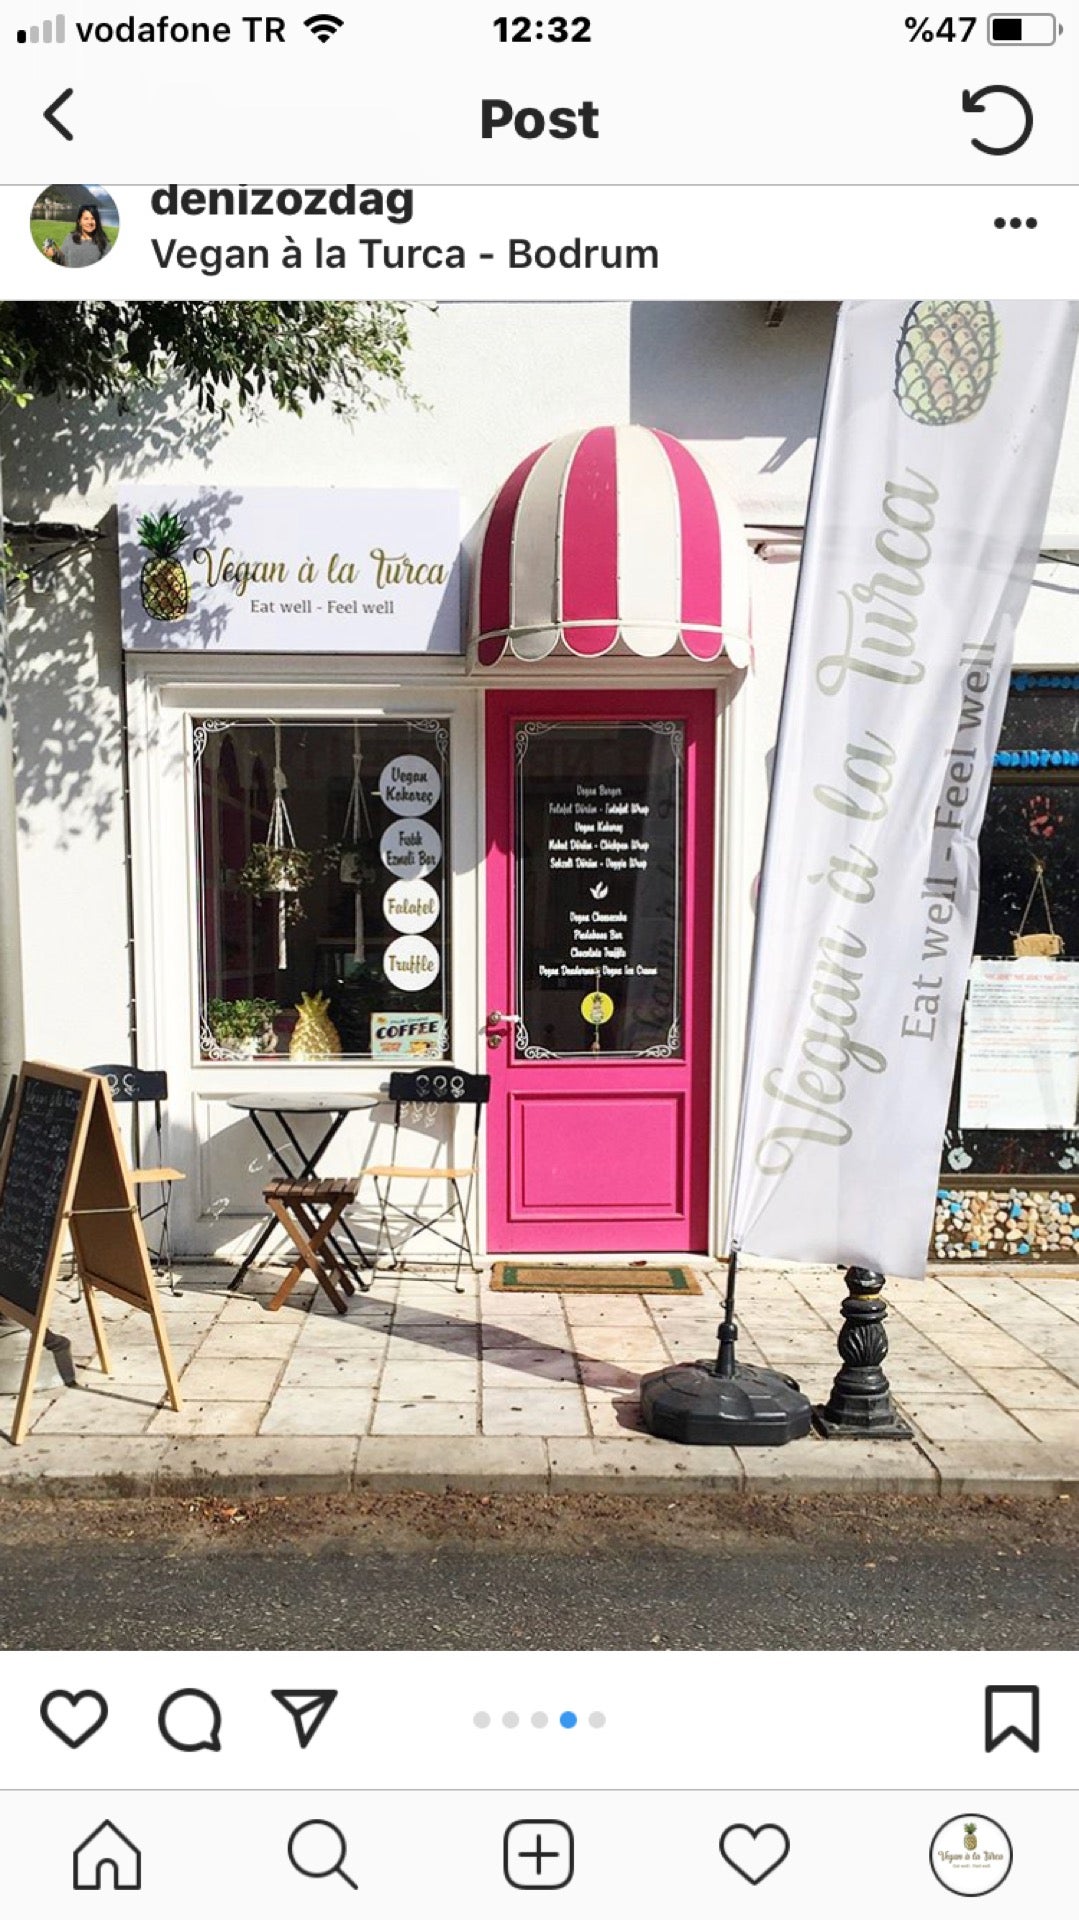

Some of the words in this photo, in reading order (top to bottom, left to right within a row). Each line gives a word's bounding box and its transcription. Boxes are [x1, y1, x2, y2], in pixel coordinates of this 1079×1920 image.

[193, 547, 289, 597] Vegan
[298, 556, 319, 583] à
[328, 553, 360, 584] la
[370, 548, 449, 589] Turca
[816, 467, 940, 695] Turca
[251, 600, 275, 613] Eat
[280, 600, 312, 613] well
[327, 600, 358, 613] Feel
[362, 600, 394, 613] well
[958, 642, 996, 732] well
[386, 786, 433, 805] Kokoreç
[391, 767, 427, 786] Vegan
[813, 730, 896, 822] la
[934, 747, 977, 831] Feel
[418, 850, 436, 865] Bar
[807, 844, 879, 904] à
[388, 898, 434, 916] Falafel
[921, 876, 959, 961] well
[388, 955, 434, 973] Truffle
[376, 1020, 439, 1039] COFFEE
[901, 973, 944, 1042] Eat
[755, 925, 887, 1176] Vegan
